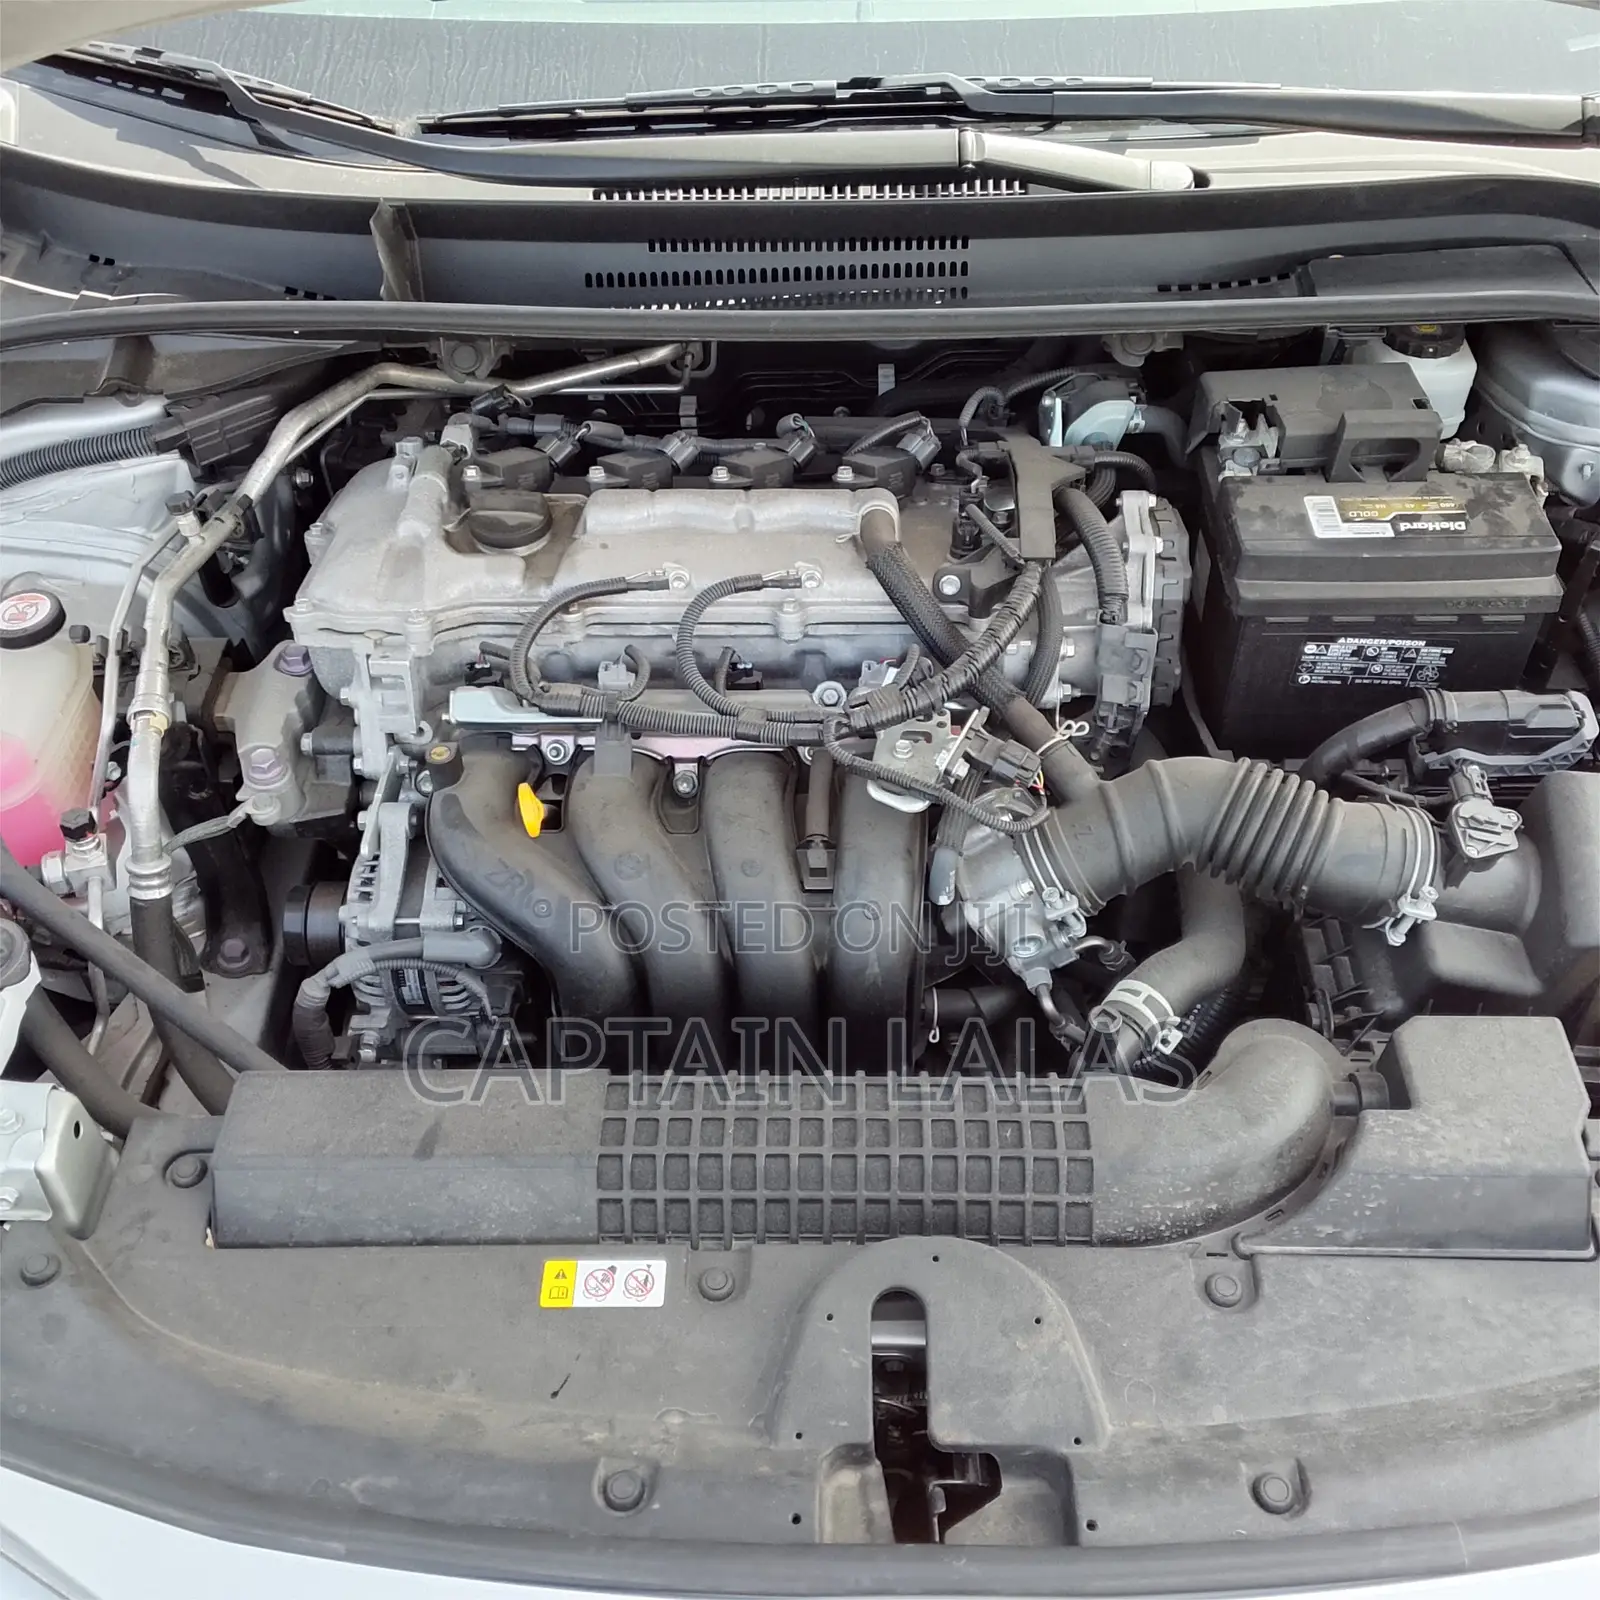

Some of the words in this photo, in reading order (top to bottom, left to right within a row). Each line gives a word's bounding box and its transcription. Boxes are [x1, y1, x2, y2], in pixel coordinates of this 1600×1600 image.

[1349, 510, 1378, 518] GOLD
[1400, 521, 1467, 532] DieHard
[1346, 637, 1427, 647] DANGER/POISON
